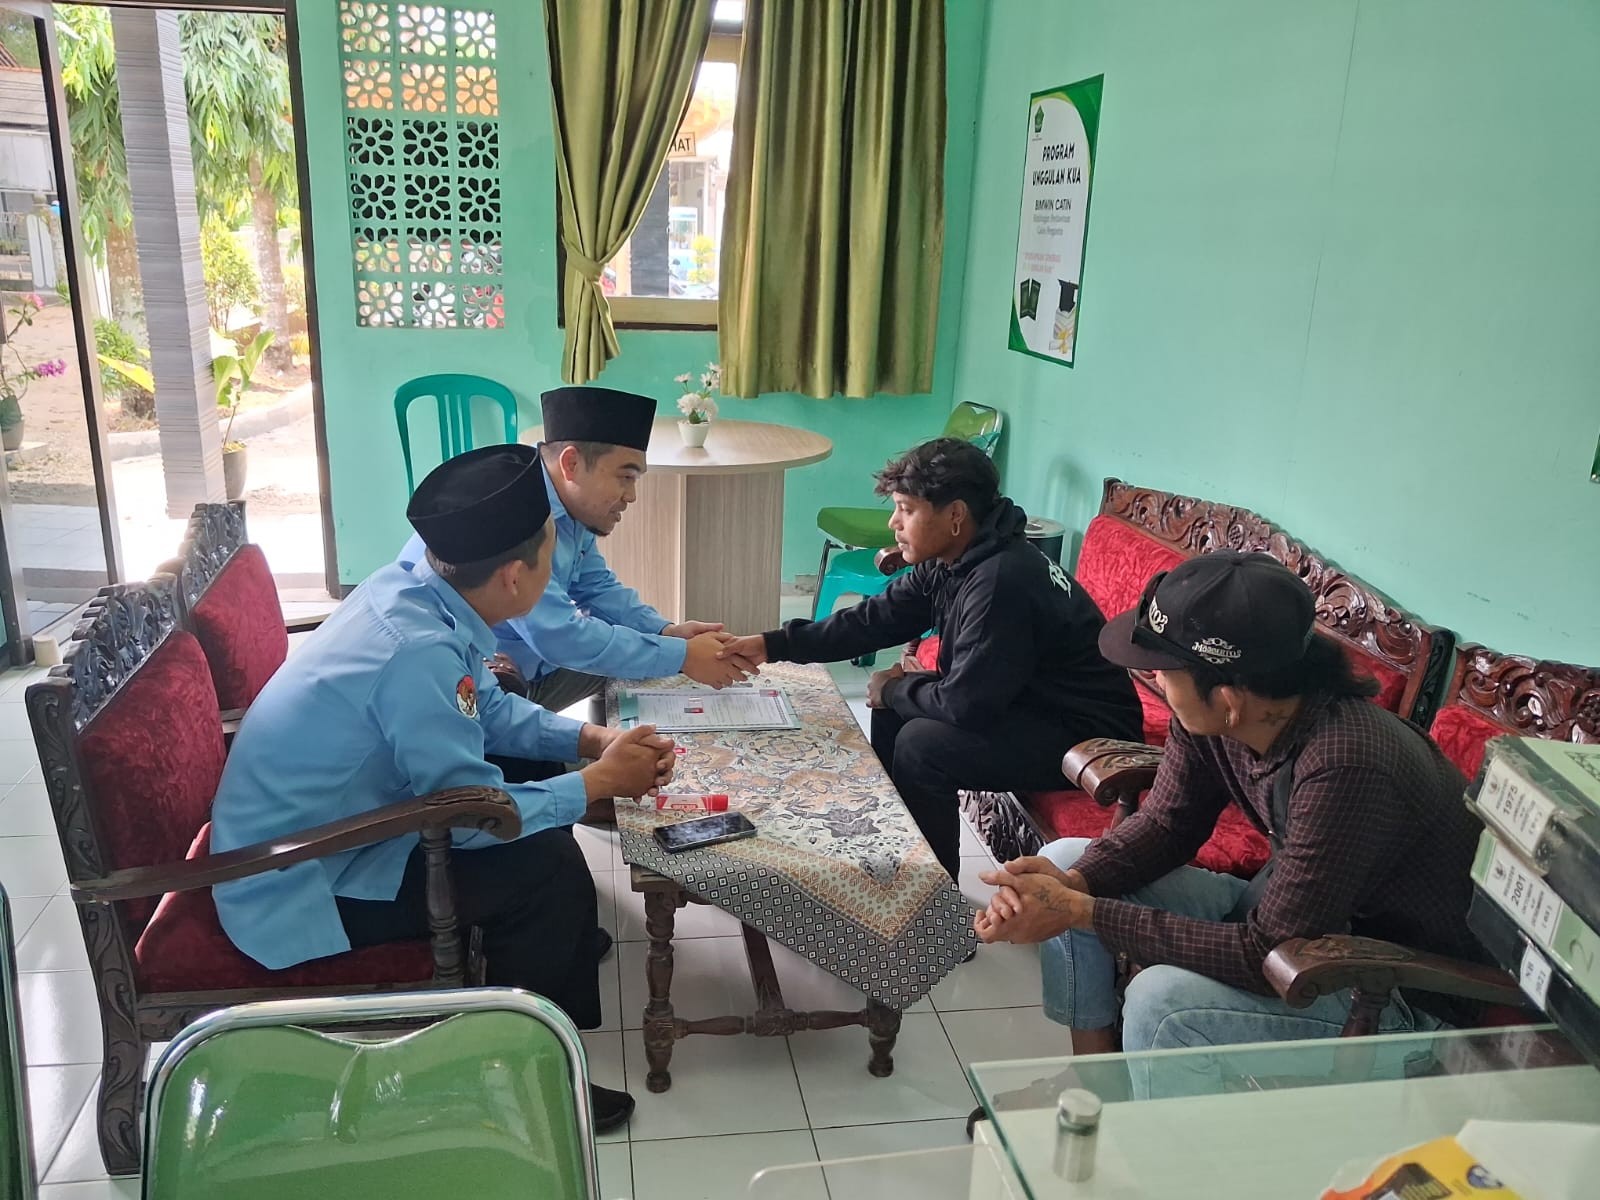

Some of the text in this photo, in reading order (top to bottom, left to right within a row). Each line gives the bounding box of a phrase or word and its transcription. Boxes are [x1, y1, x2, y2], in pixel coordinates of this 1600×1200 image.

[1042, 143, 1075, 162] PROGRAM
[1032, 166, 1081, 186] UNGGULAN KUA
[1055, 198, 1072, 211] CATIN
[1503, 785, 1518, 815] 1975
[1511, 874, 1526, 906] 2001
